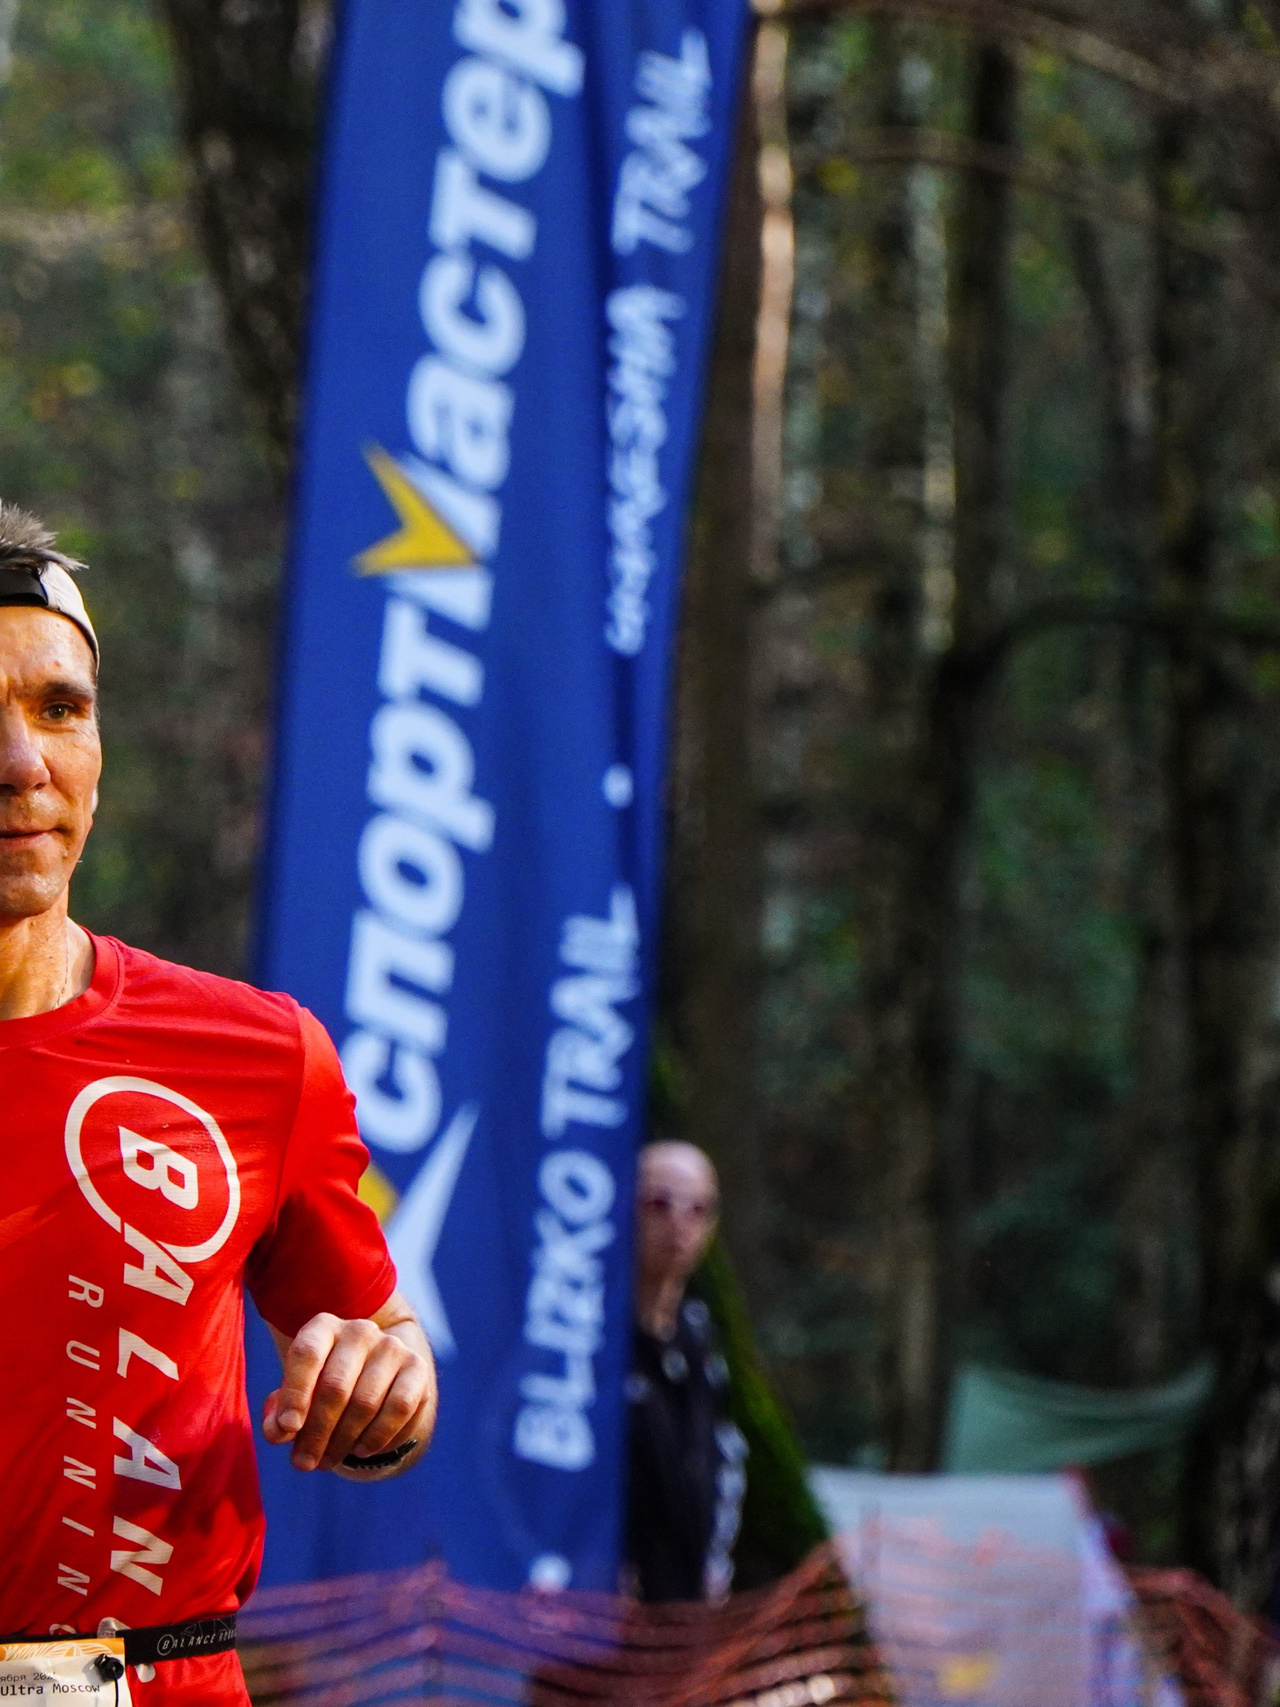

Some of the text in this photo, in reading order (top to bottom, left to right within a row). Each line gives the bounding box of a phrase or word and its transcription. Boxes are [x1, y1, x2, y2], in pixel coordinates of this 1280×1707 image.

[515, 880, 640, 1472] BLIZKO TRAIL
[49, 1274, 104, 1636] RUNNIN
[0, 1684, 44, 1696] Ultra
[52, 1682, 101, 1694] Moscow
[158, 1633, 216, 1655] BALANCE
